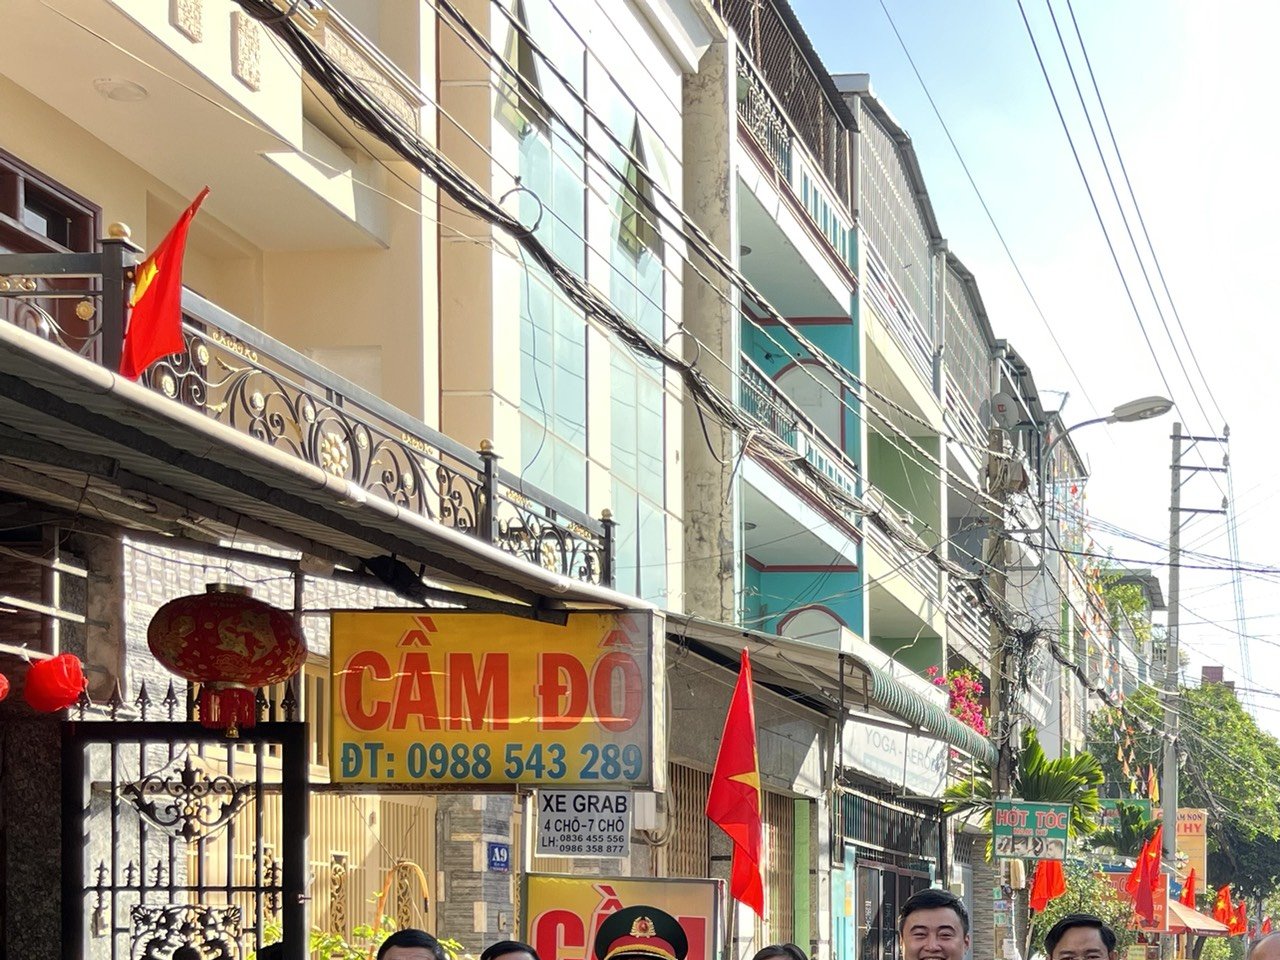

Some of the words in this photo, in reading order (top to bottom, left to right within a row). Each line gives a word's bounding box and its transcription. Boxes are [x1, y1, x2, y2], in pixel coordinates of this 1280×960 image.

[341, 616, 510, 733] CẦM
[534, 613, 645, 733] ĐỒ
[865, 726, 897, 757] YOGA
[341, 742, 396, 779] ĐT:
[407, 742, 492, 779] 0988
[505, 742, 568, 779] 543
[579, 742, 644, 780] 289
[542, 794, 567, 813] XE
[573, 794, 627, 813] GRAB
[541, 836, 559, 848] LH:
[559, 834, 584, 842] 0836
[586, 835, 604, 843] 455
[606, 835, 625, 843] 556
[559, 844, 583, 852] 0986
[586, 844, 603, 853] 358
[606, 845, 624, 853] 877
